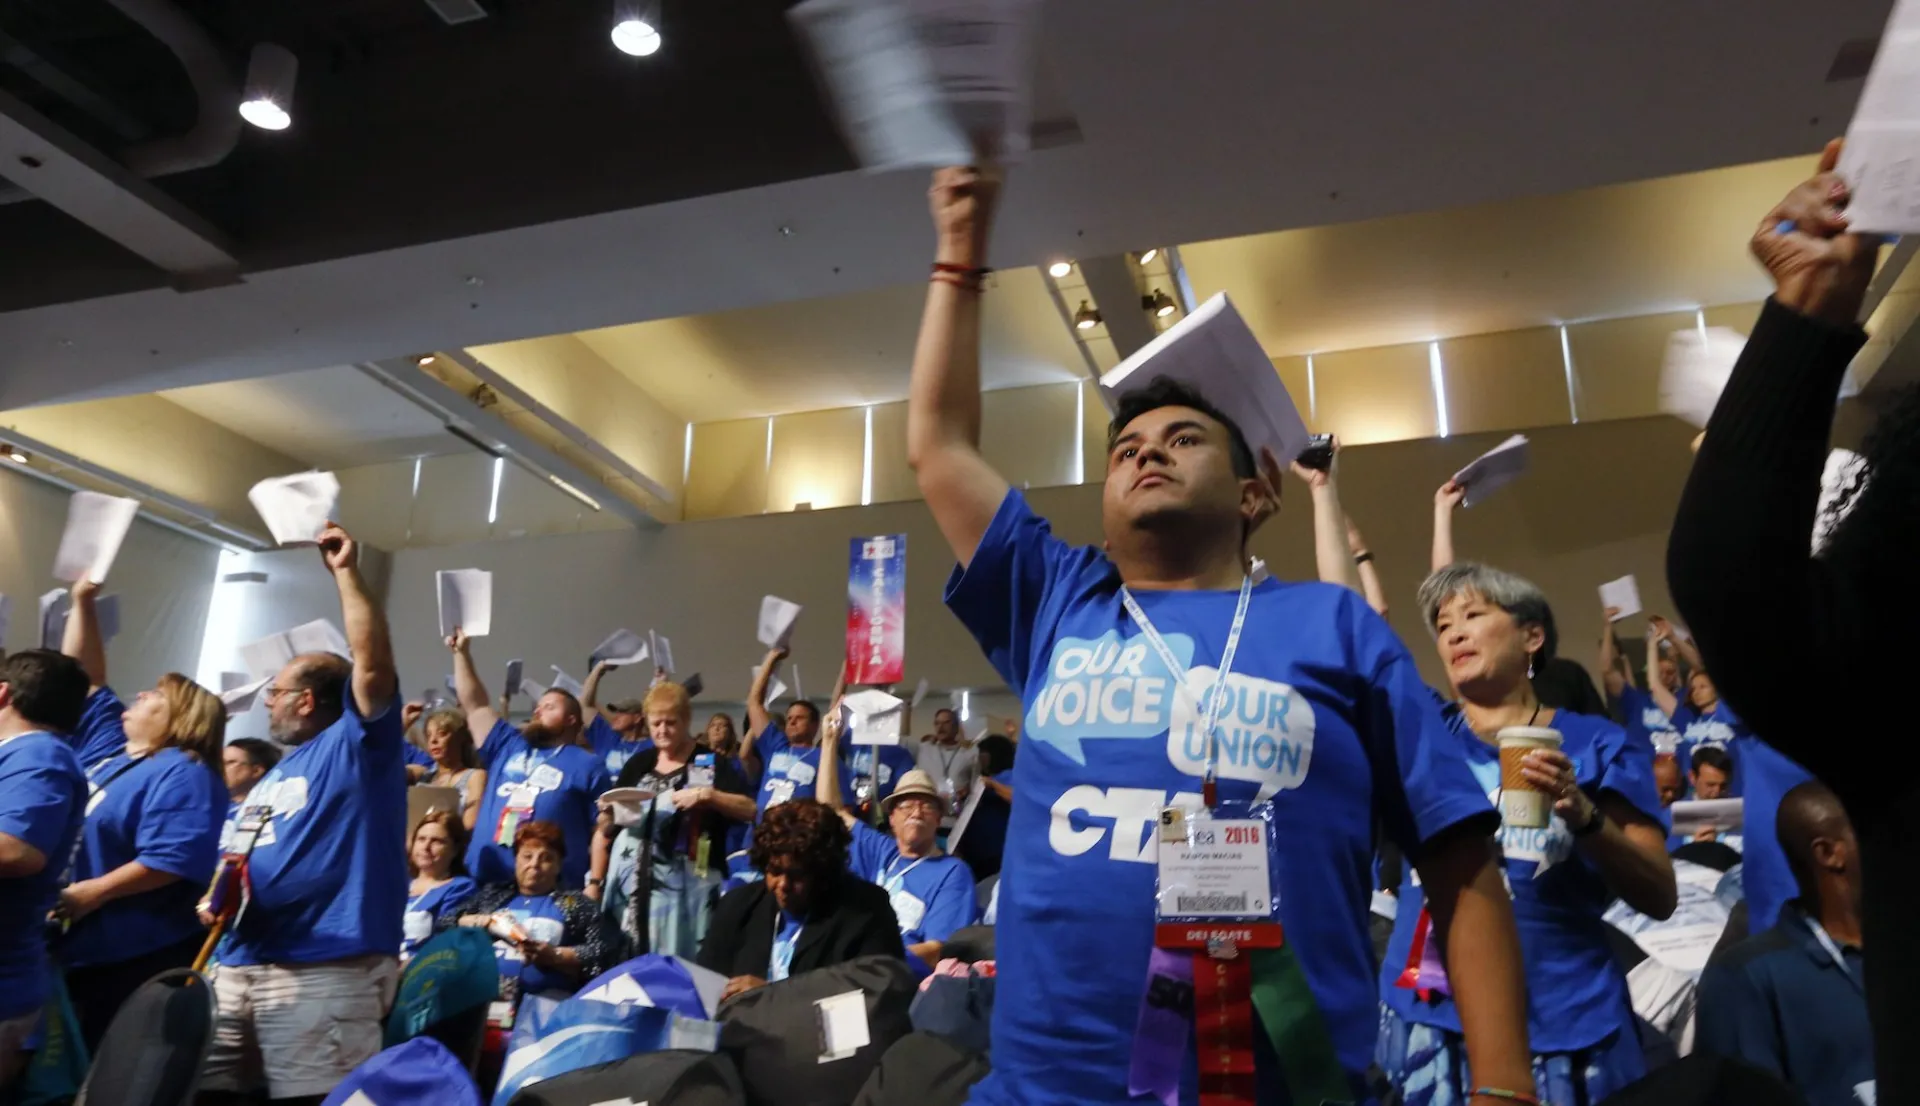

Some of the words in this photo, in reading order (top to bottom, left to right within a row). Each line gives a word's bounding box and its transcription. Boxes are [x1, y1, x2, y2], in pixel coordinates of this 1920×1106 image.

[1055, 641, 1148, 679] OUR
[1036, 677, 1166, 727] VOICE
[1202, 685, 1290, 732] OUR
[1183, 724, 1302, 776] UNION
